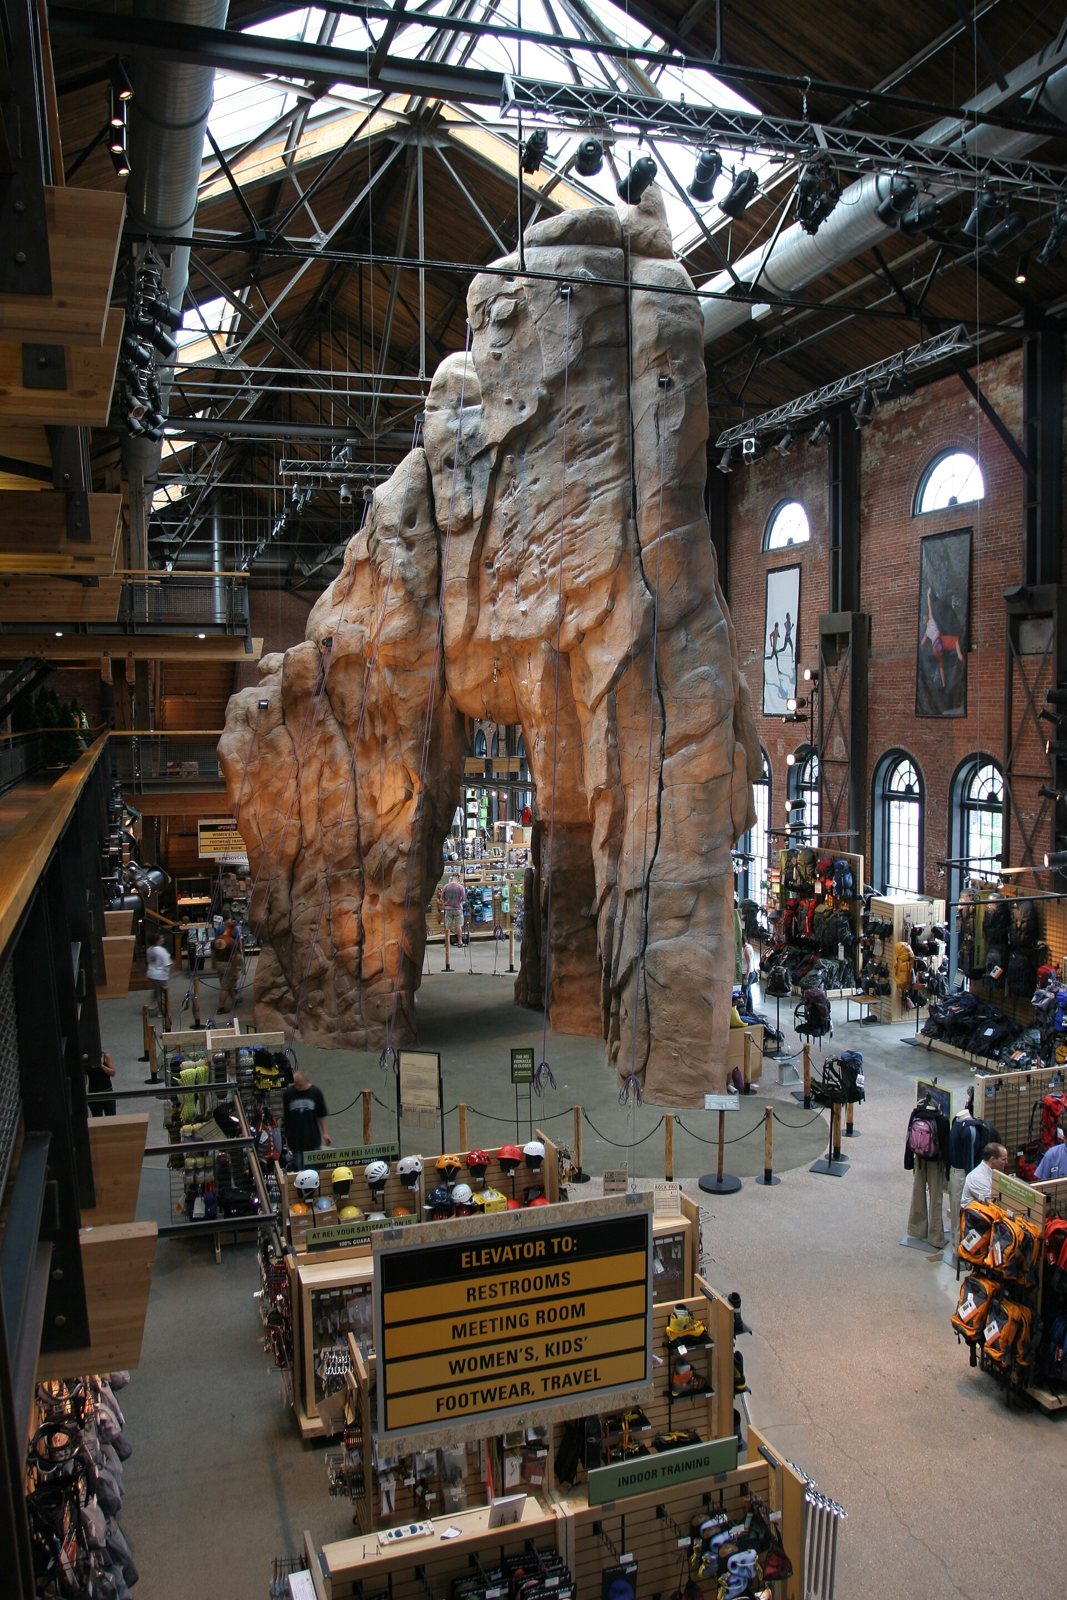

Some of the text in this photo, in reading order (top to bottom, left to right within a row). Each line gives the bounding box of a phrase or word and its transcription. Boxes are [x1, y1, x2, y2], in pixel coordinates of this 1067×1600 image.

[307, 1145, 395, 1161] BECOME AN REI MEMBER
[336, 1228, 355, 1236] YOUR
[356, 1221, 404, 1234] SATISFACTON
[461, 1236, 577, 1269] ELEVATOR TO:
[466, 1271, 571, 1303] RESTROOMS
[451, 1302, 586, 1340] MEETING ROOM
[448, 1336, 588, 1376] WOMEN'S, KIDS'
[436, 1367, 602, 1413] FOOTWEAR, TRAVEL
[618, 1456, 710, 1487] INDOOR TRAINING
